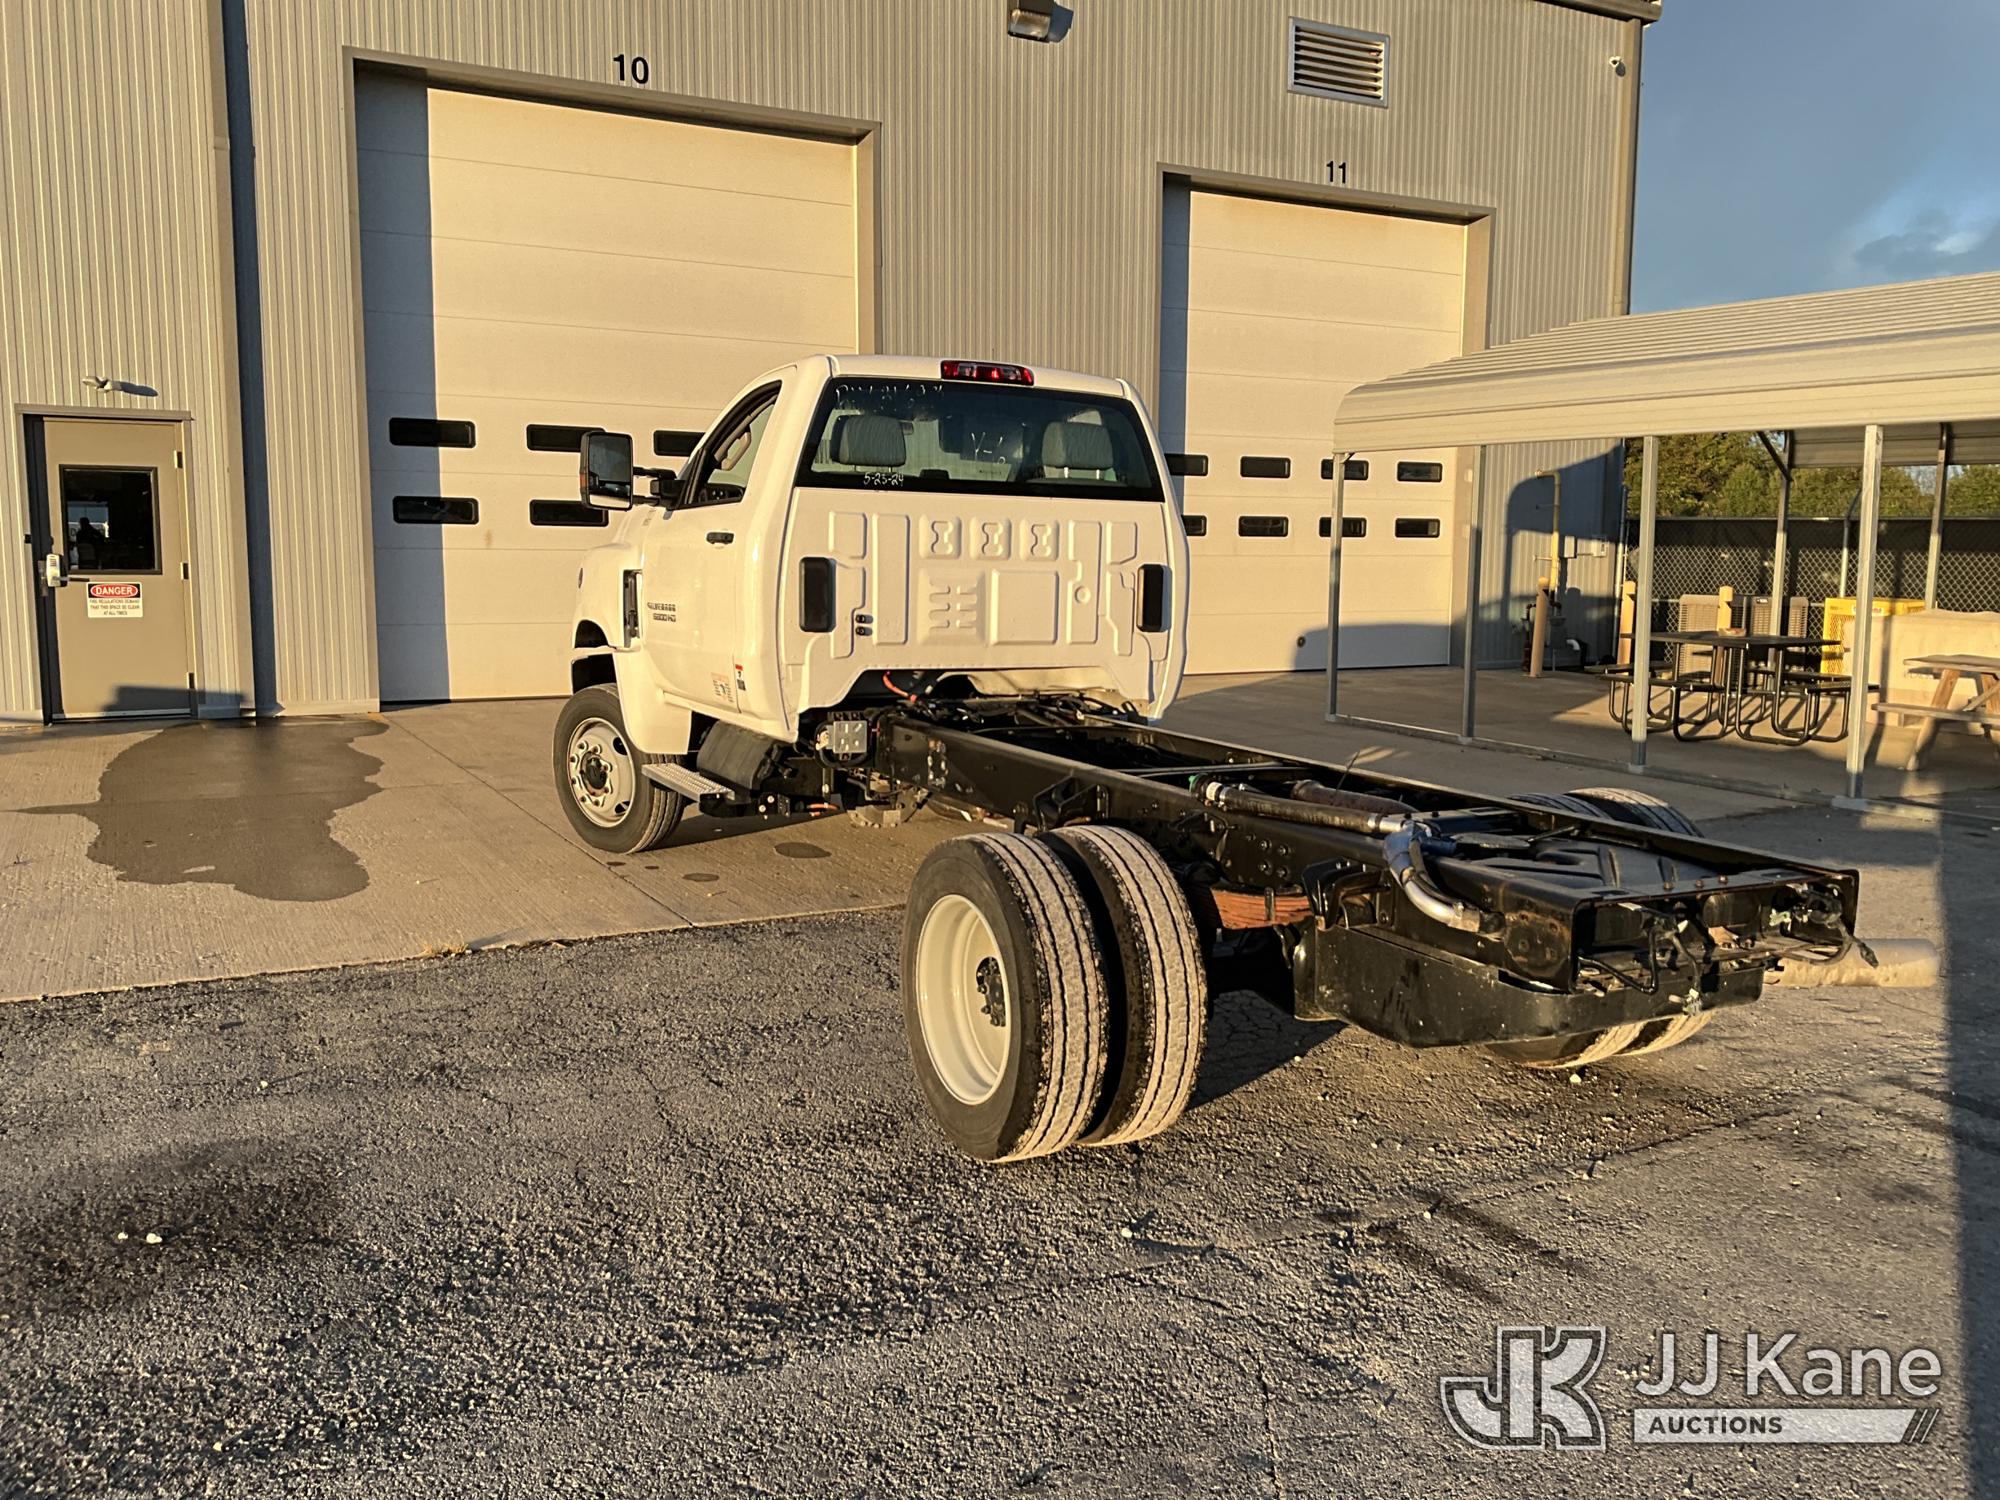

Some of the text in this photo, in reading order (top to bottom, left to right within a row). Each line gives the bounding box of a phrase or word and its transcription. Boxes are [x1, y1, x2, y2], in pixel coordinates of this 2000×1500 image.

[613, 54, 649, 84] 10
[1326, 160, 1346, 184] 11
[95, 586, 133, 595] DANGER
